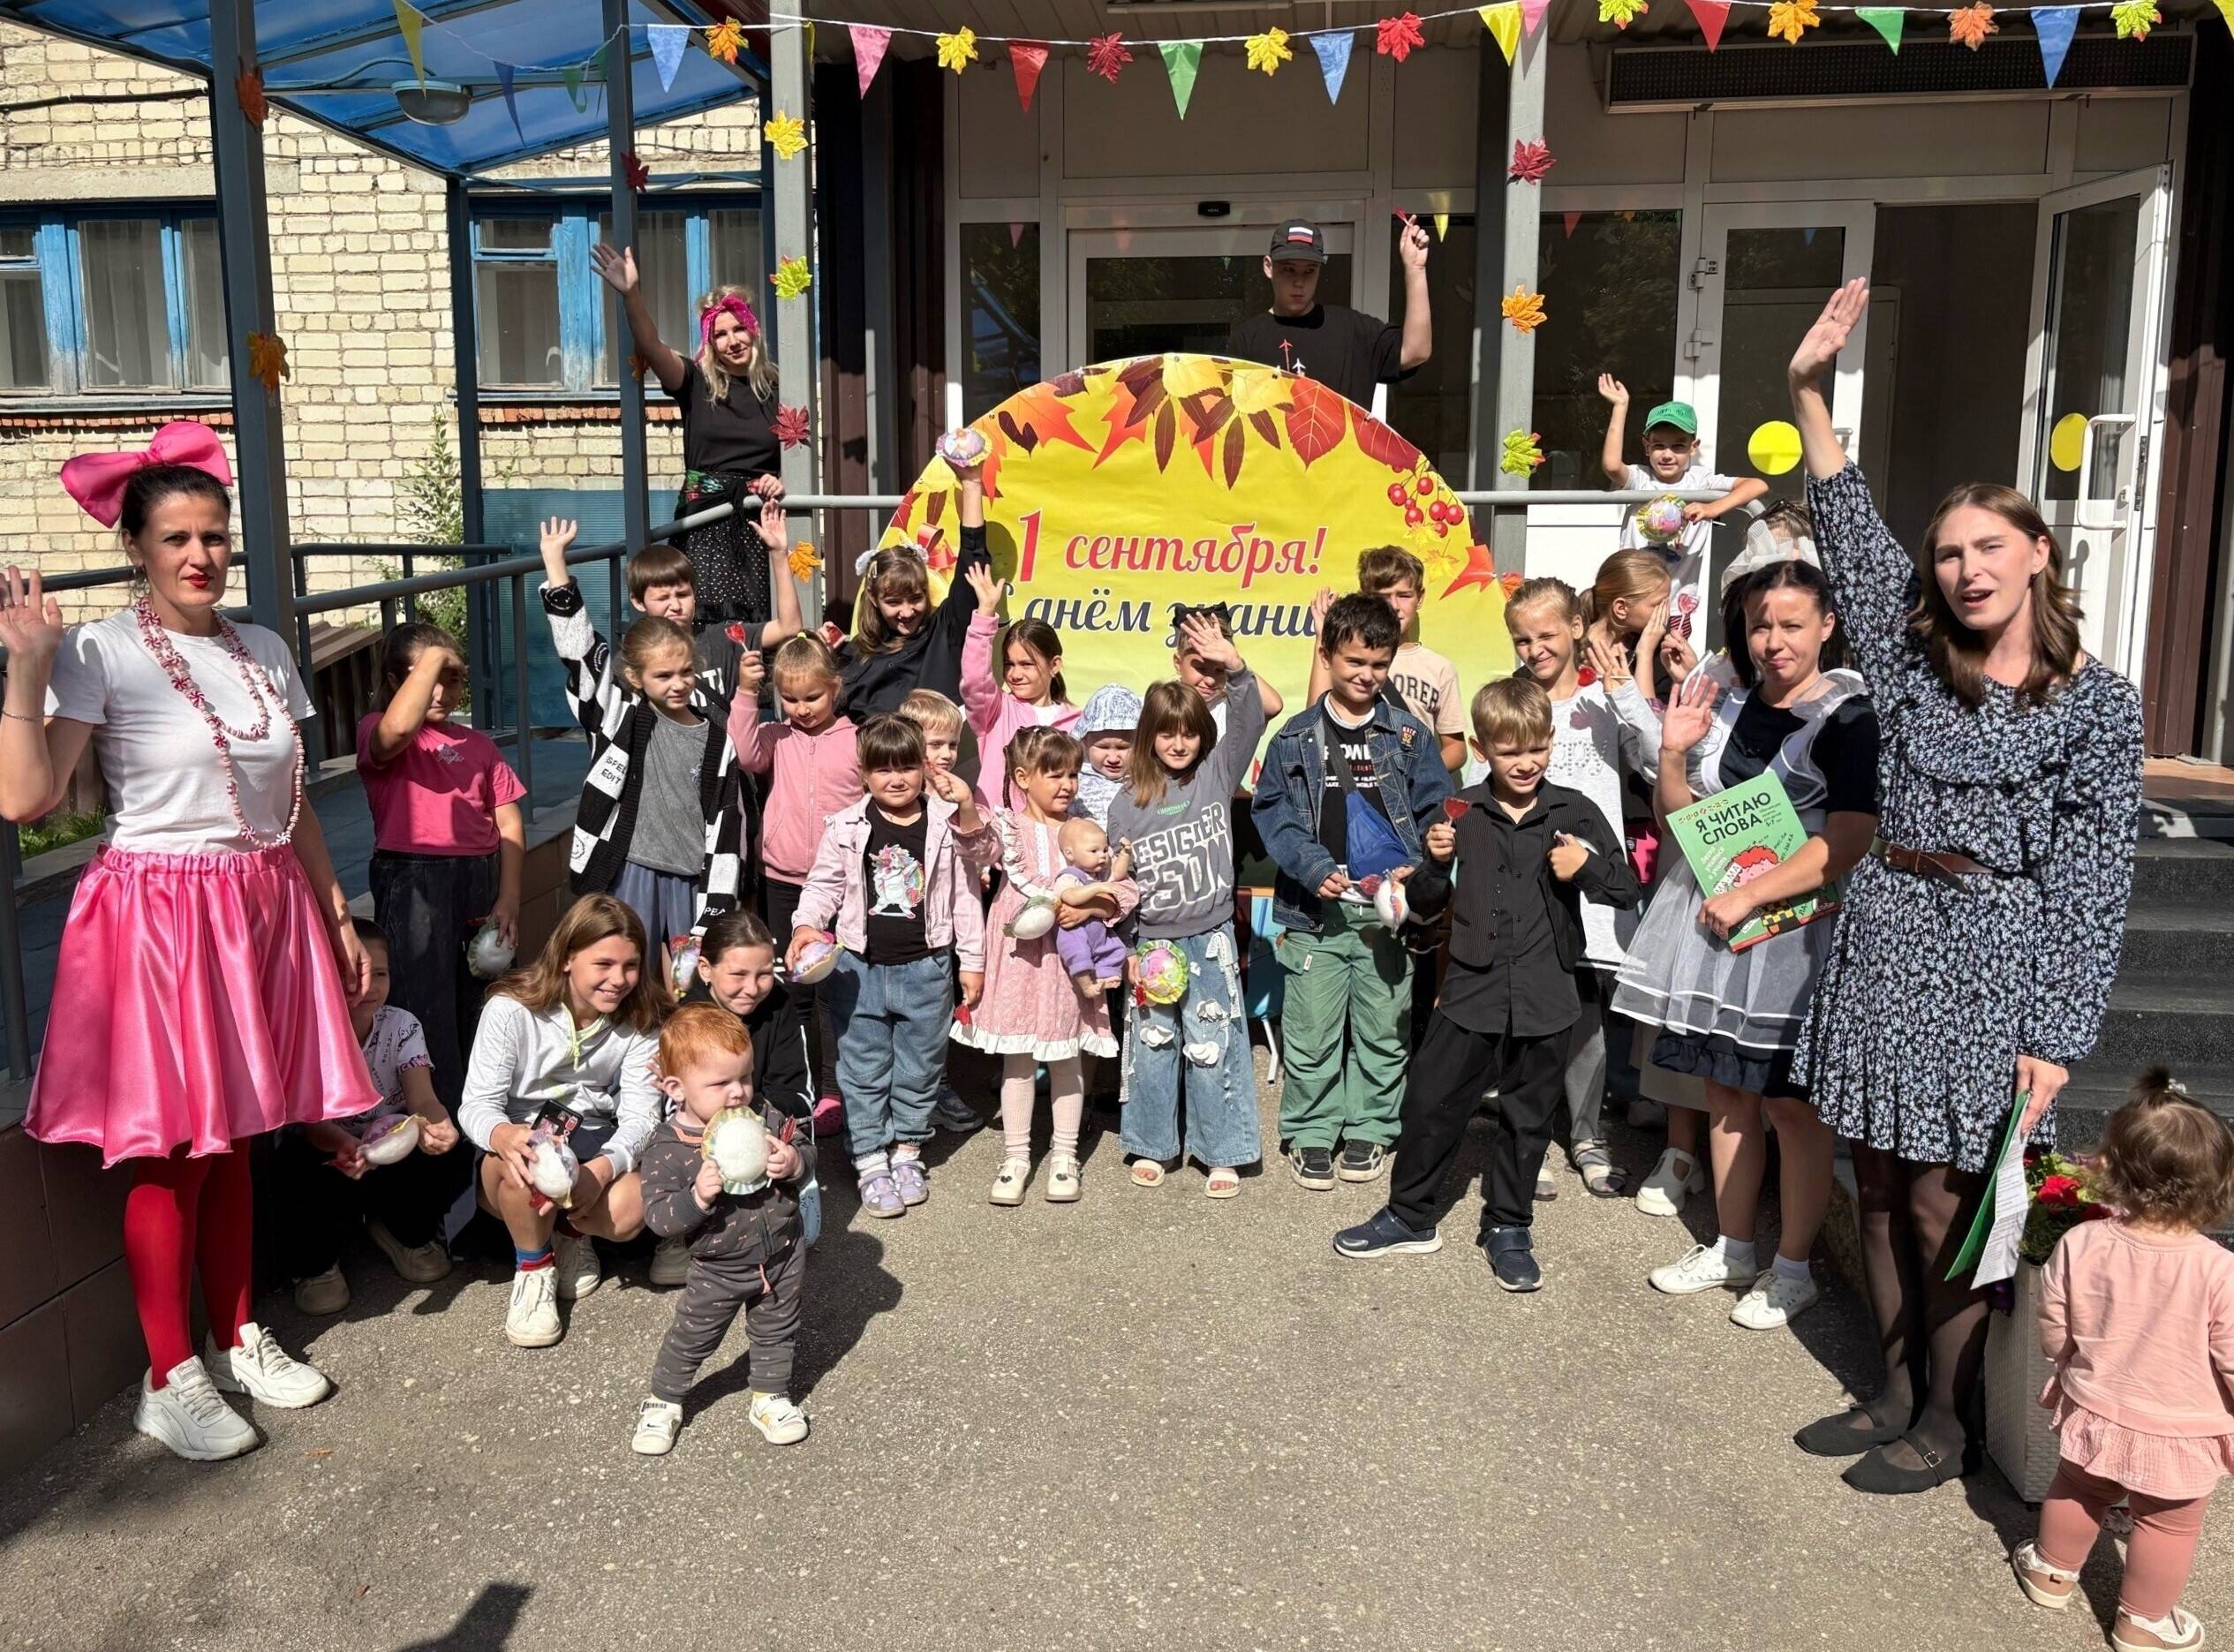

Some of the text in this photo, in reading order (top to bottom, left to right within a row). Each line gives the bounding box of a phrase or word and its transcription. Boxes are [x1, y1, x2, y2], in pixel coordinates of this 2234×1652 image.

[1019, 509, 1328, 589] 1 сентября!
[1393, 674, 1440, 713] ORER
[600, 769, 623, 785] EDIT
[1695, 818, 1708, 834] Я
[1709, 792, 1771, 826] ЧИТАЮ
[1702, 812, 1763, 845] СЛОВА
[1716, 864, 1741, 894] МА-МА
